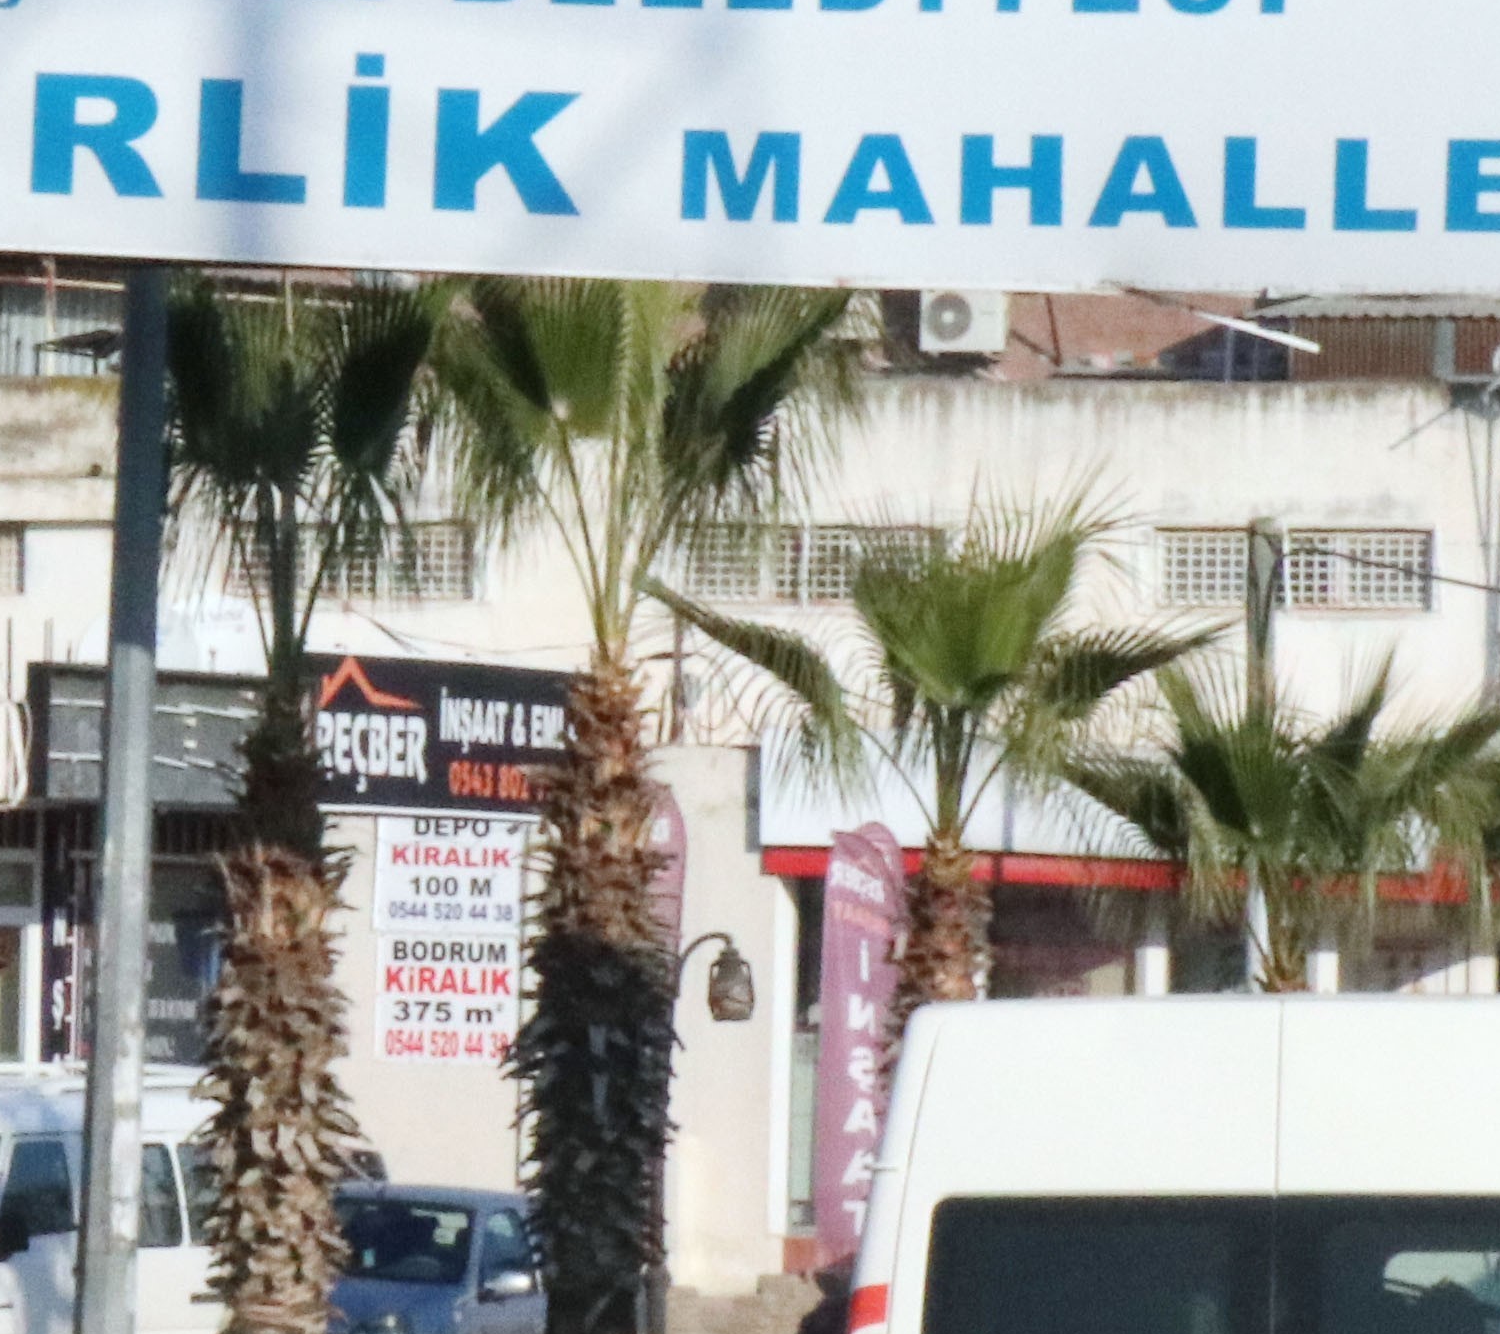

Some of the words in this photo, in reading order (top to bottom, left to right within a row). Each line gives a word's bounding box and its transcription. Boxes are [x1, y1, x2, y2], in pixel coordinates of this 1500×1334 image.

[440, 686, 509, 754] İNŞAAT
[511, 703, 527, 747] &
[413, 819, 490, 838] DEPO
[391, 841, 510, 868] KİRALIK
[411, 876, 459, 897] 100
[388, 900, 428, 919] 0544
[433, 902, 463, 920] 520
[468, 904, 488, 920] 44
[393, 940, 507, 963] BODRUM
[394, 1000, 452, 1023] 375
[385, 1029, 425, 1056] 0544
[430, 1031, 460, 1058] 520
[464, 1033, 485, 1057] 44
